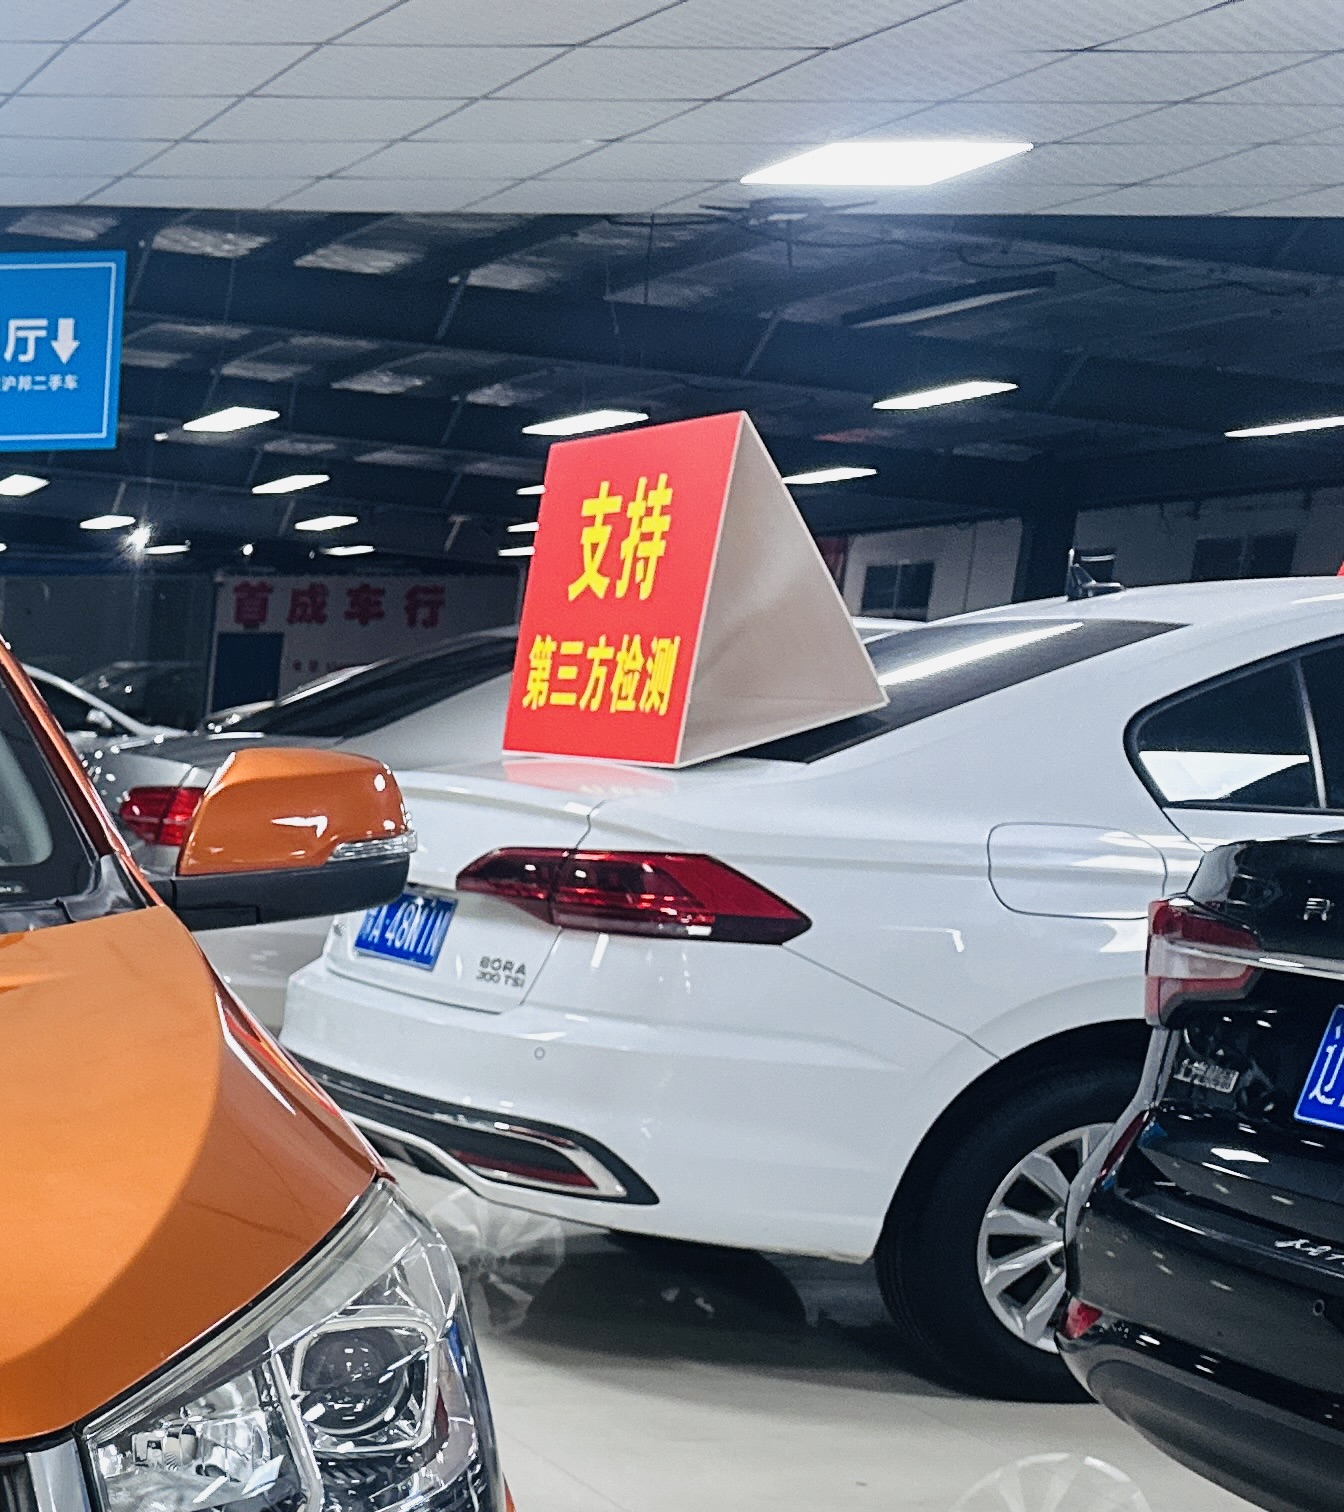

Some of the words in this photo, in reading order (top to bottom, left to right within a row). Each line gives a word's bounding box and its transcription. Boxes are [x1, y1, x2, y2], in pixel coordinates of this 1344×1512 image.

[567, 472, 674, 602] 支持
[521, 634, 681, 717] 第三方检测
[479, 955, 526, 976] BORA
